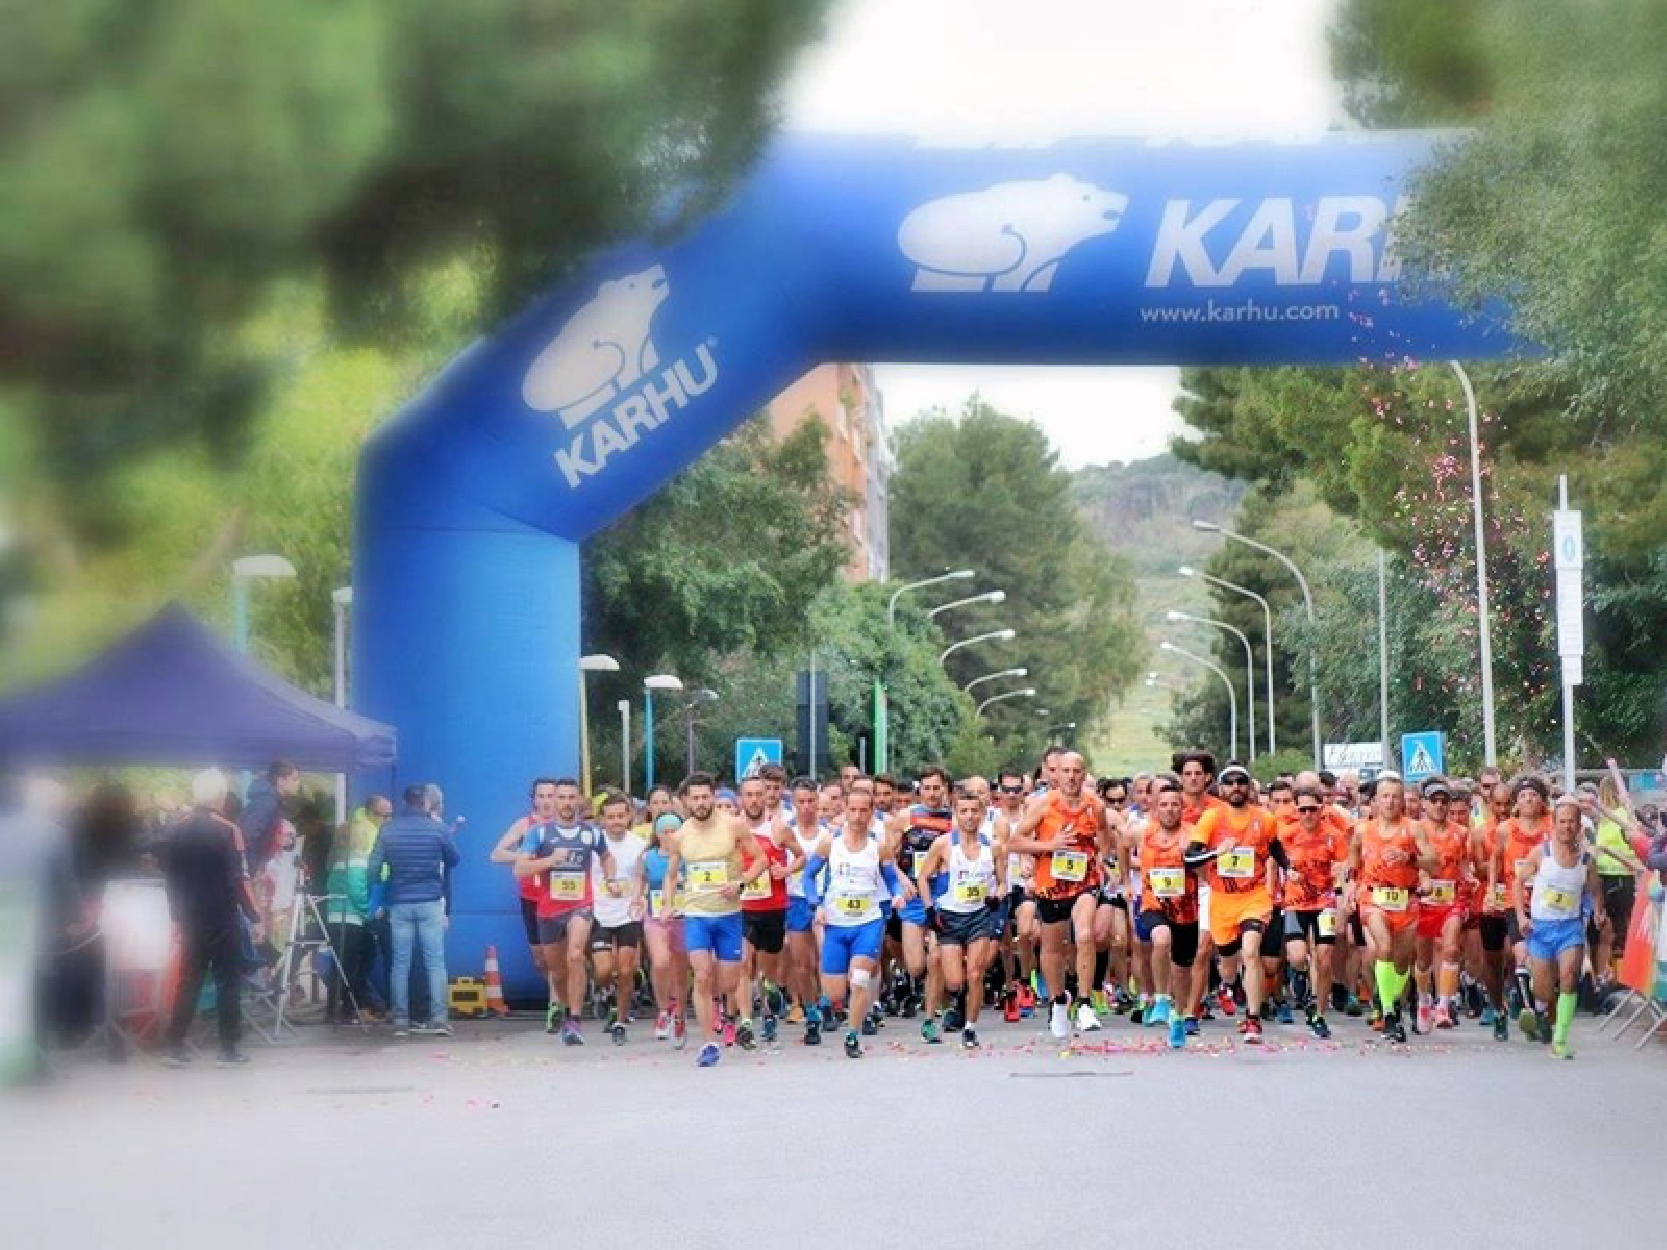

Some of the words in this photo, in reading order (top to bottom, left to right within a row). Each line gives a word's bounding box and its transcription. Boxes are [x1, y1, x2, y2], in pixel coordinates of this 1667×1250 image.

[1144, 195, 1402, 288] KAR
[1140, 299, 1340, 322] www.karhu.com
[554, 343, 718, 487] KARHU
